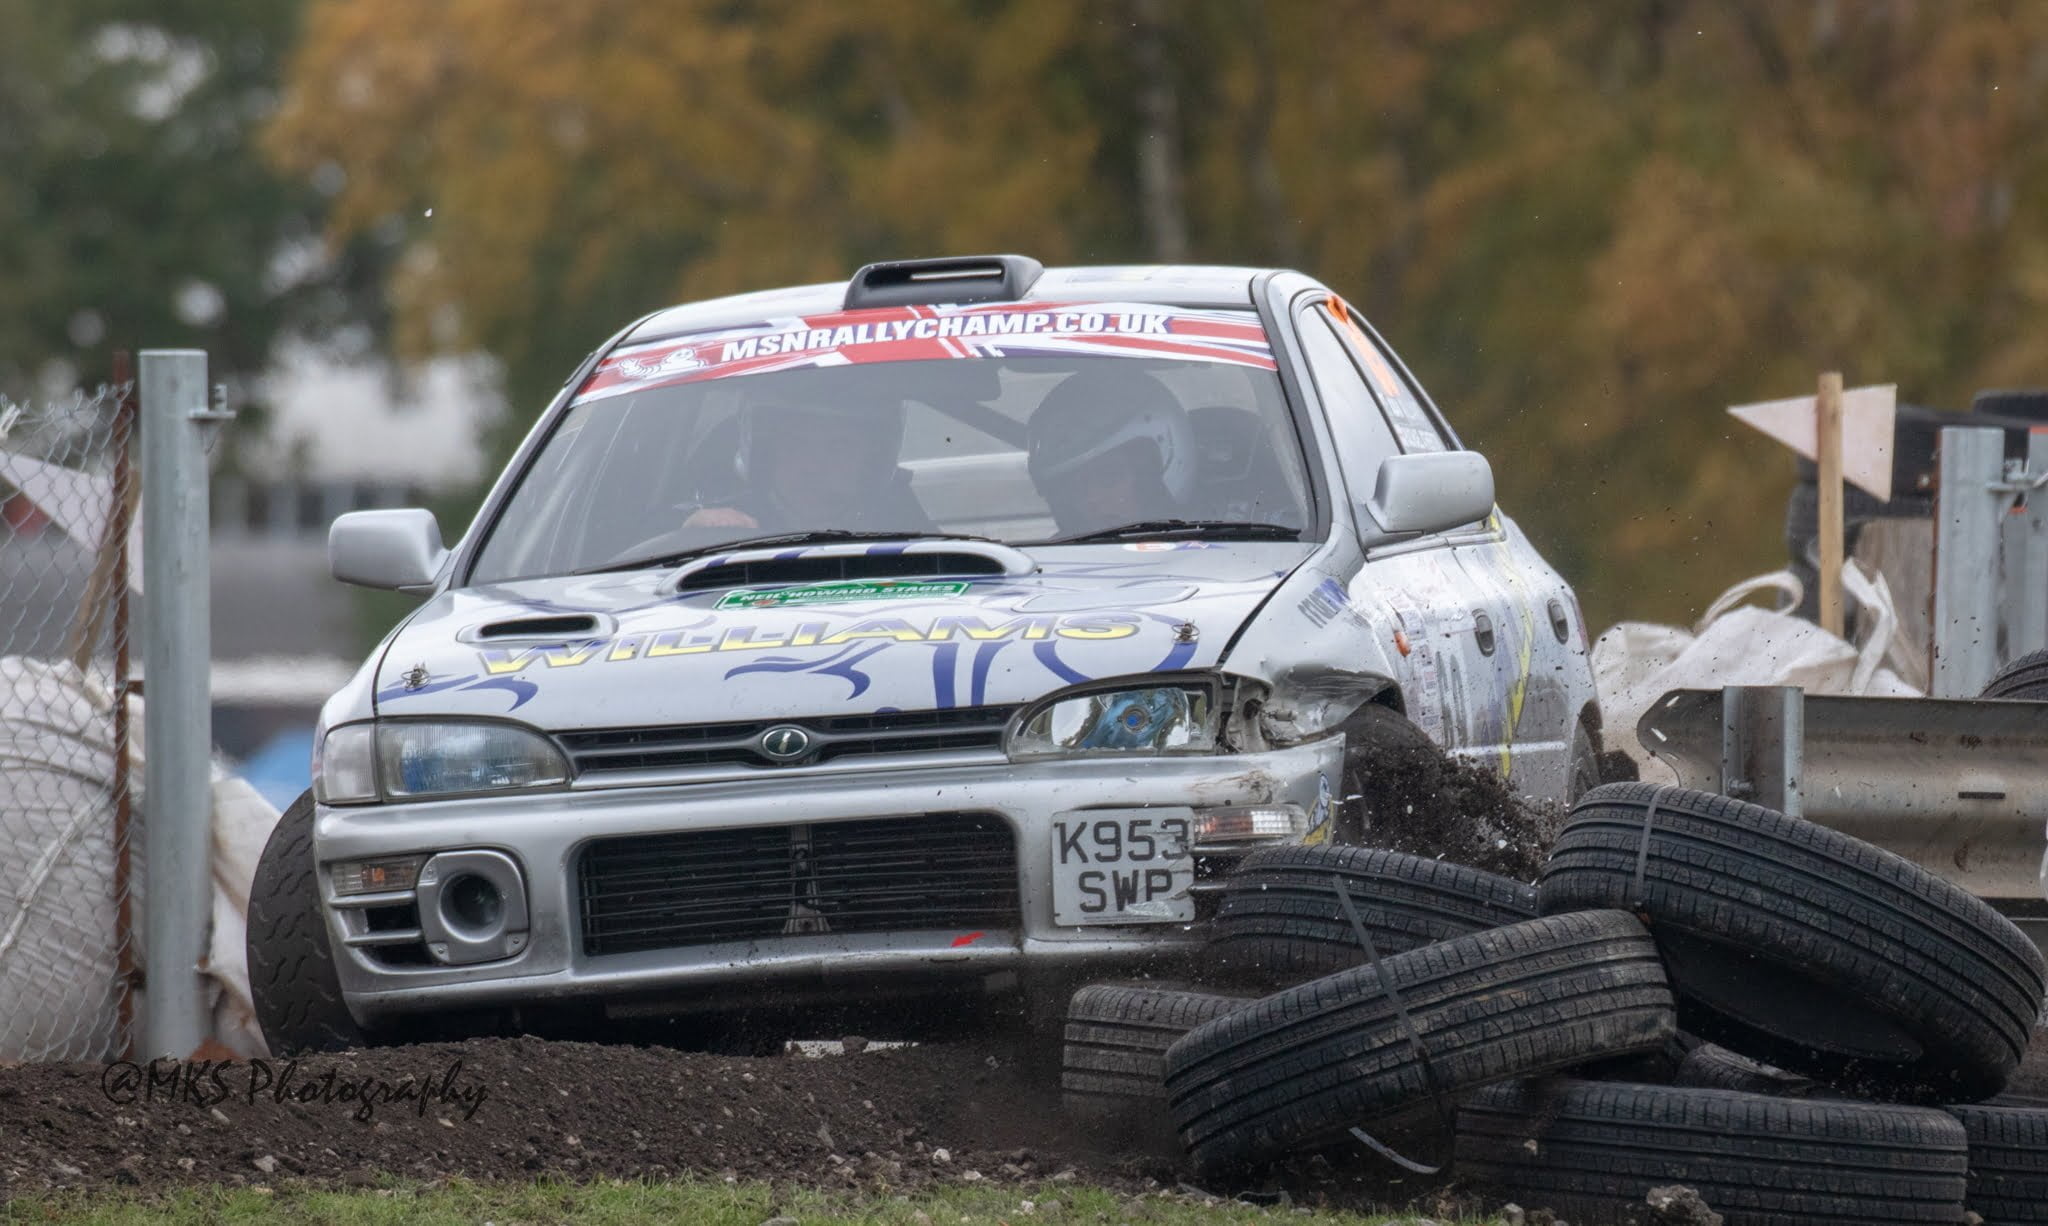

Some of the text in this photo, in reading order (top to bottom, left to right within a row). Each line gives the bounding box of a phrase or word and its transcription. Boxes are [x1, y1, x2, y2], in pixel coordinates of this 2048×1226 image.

[721, 312, 1170, 362] MSNRALLYCHAMP.CO.UK
[740, 591, 782, 601] NEIL
[787, 587, 877, 599] HOWARD
[881, 584, 957, 593] STAGES
[476, 611, 1142, 676] WILLIAMS
[1058, 818, 1190, 864] K953
[1077, 869, 1173, 914] SWP
